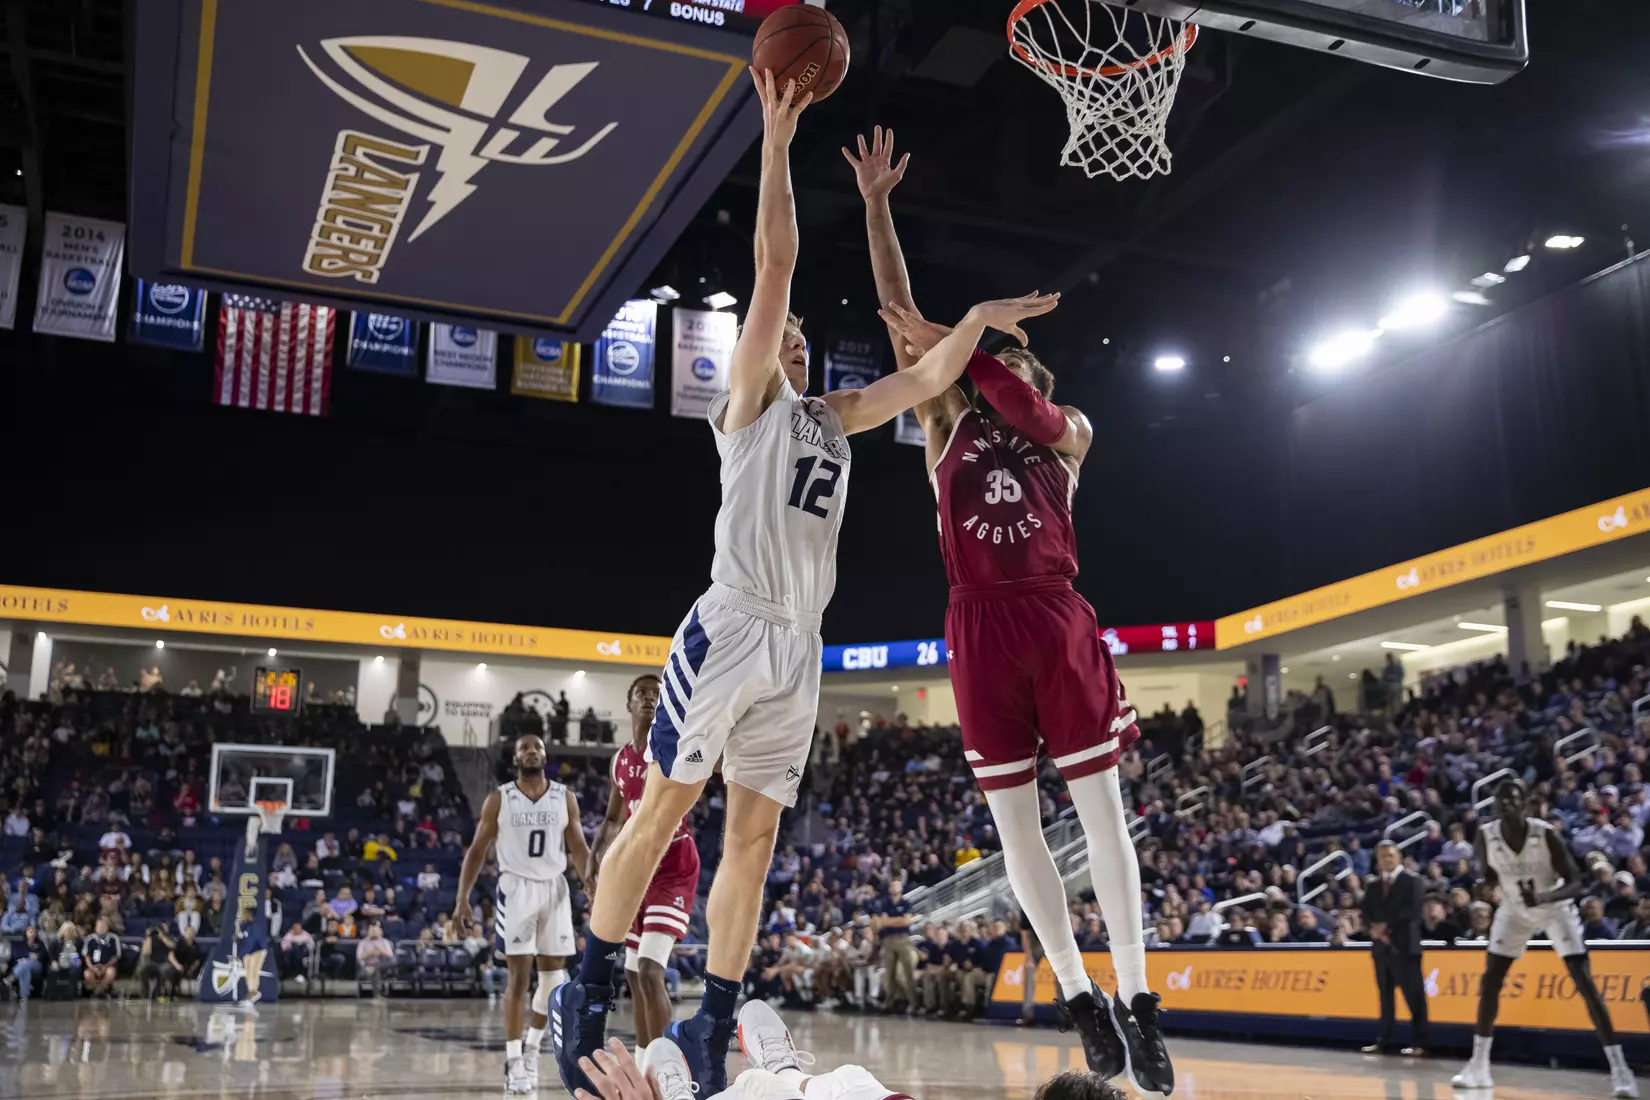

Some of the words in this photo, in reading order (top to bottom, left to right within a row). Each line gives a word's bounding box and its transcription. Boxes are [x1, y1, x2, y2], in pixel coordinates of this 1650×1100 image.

[670, 2, 726, 27] BONUS
[302, 129, 431, 285] LANCERS
[61, 224, 106, 243] 2014
[592, 373, 651, 390] CHAMPIONS
[788, 455, 842, 519] 12
[984, 467, 1023, 505] 35
[962, 512, 1043, 544] AGGIES
[0, 595, 69, 613] OTELS
[174, 609, 234, 625] AYRES
[241, 613, 316, 631] HOTELS
[410, 627, 464, 641] AYRES
[471, 630, 538, 648] HOTELS
[842, 646, 888, 670] CBU
[916, 641, 939, 666] 26
[268, 685, 291, 711] 18
[528, 829, 546, 858] 0
[1190, 968, 1247, 991] AYRES
[1251, 969, 1331, 994] HOTELS
